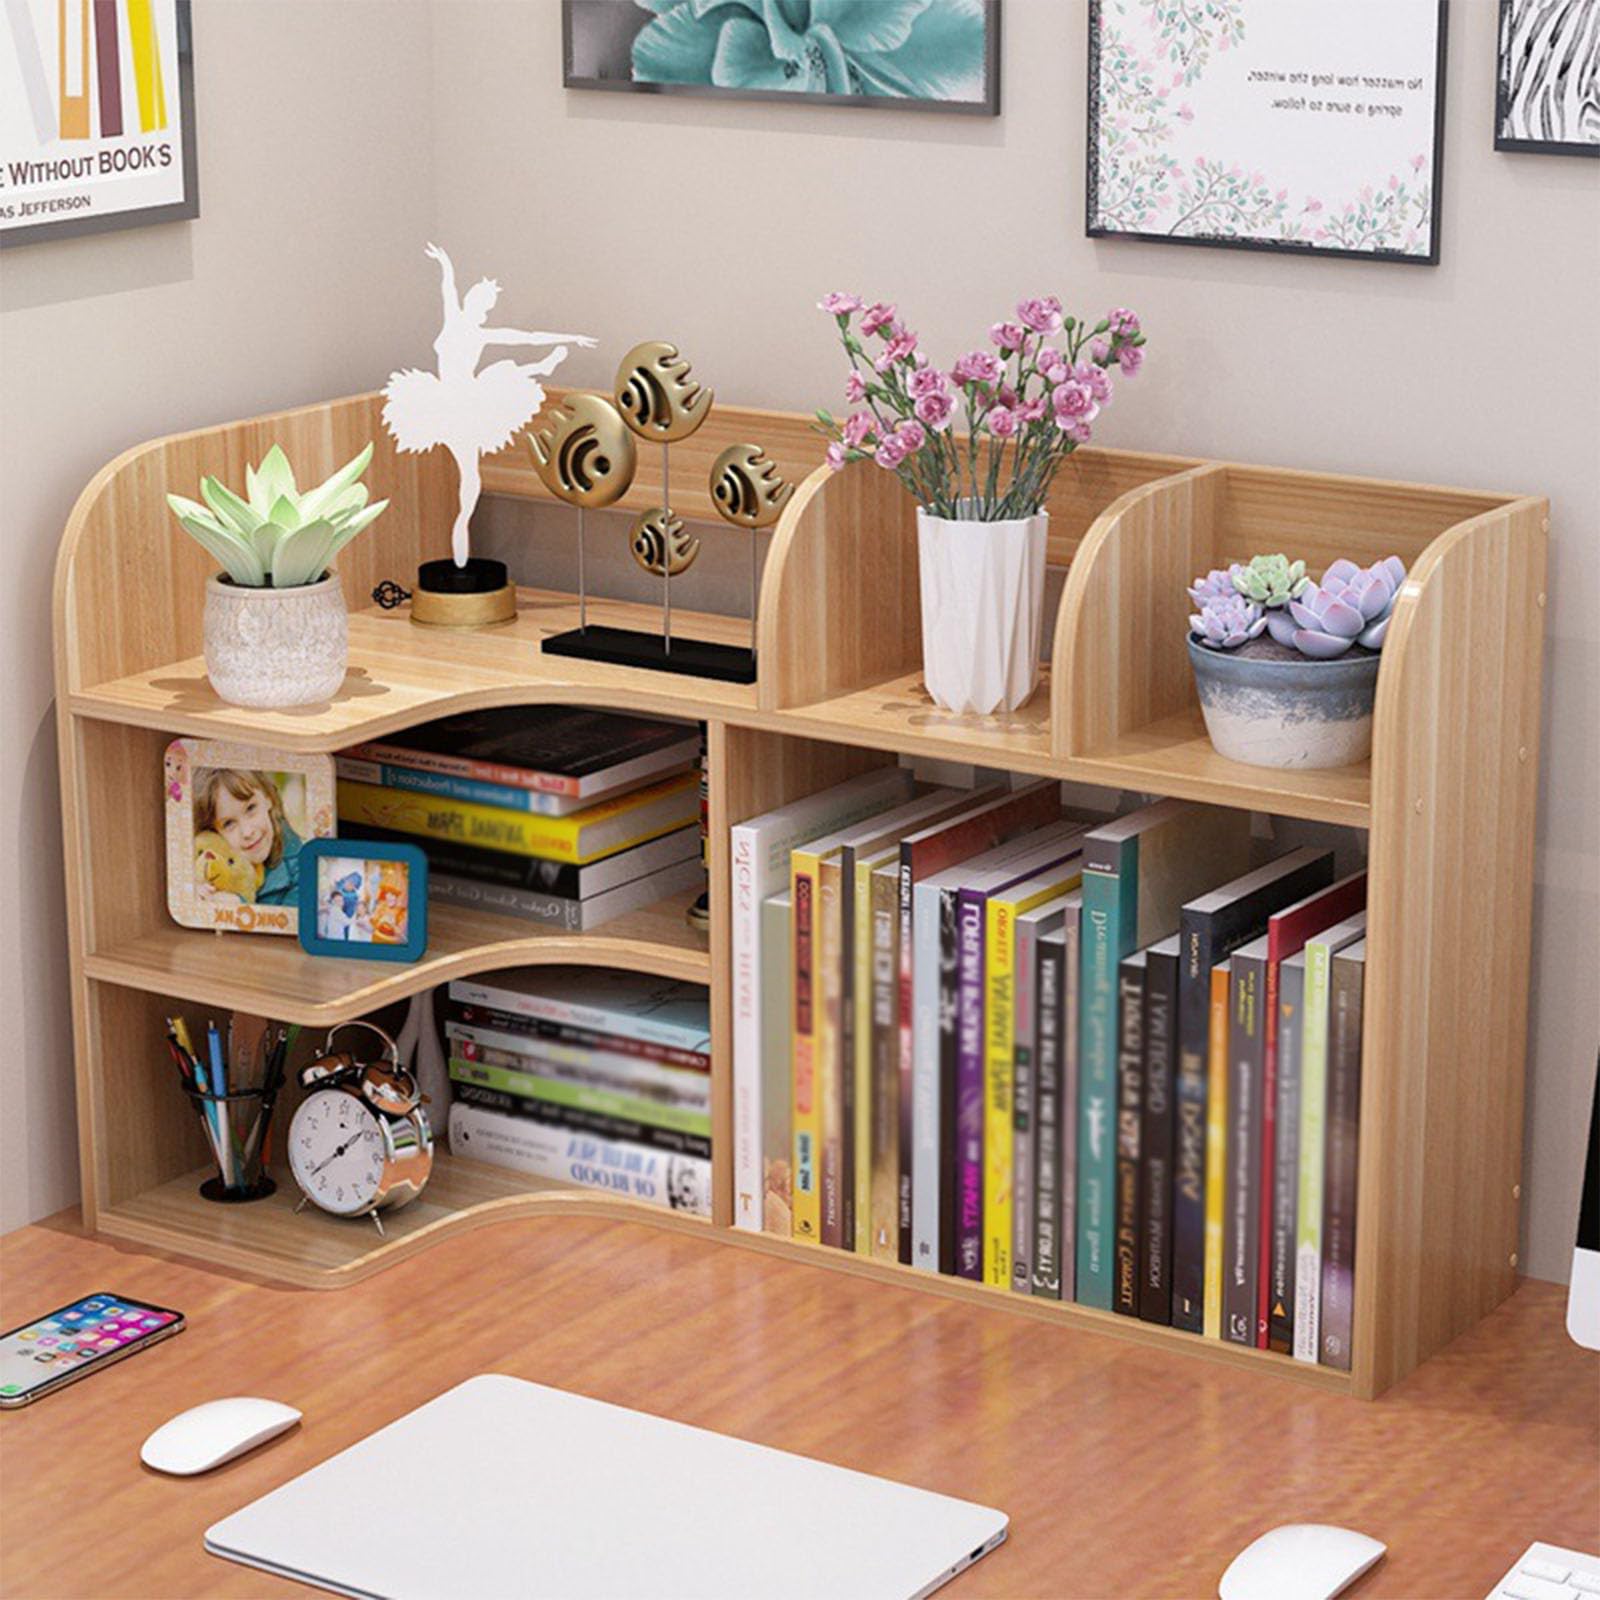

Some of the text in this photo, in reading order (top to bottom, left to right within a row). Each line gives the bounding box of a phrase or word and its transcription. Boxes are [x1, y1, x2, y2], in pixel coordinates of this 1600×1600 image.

[8, 157, 94, 186] WITHOUT
[99, 143, 172, 174] BOOKS
[18, 196, 92, 217] JEFFERSON
